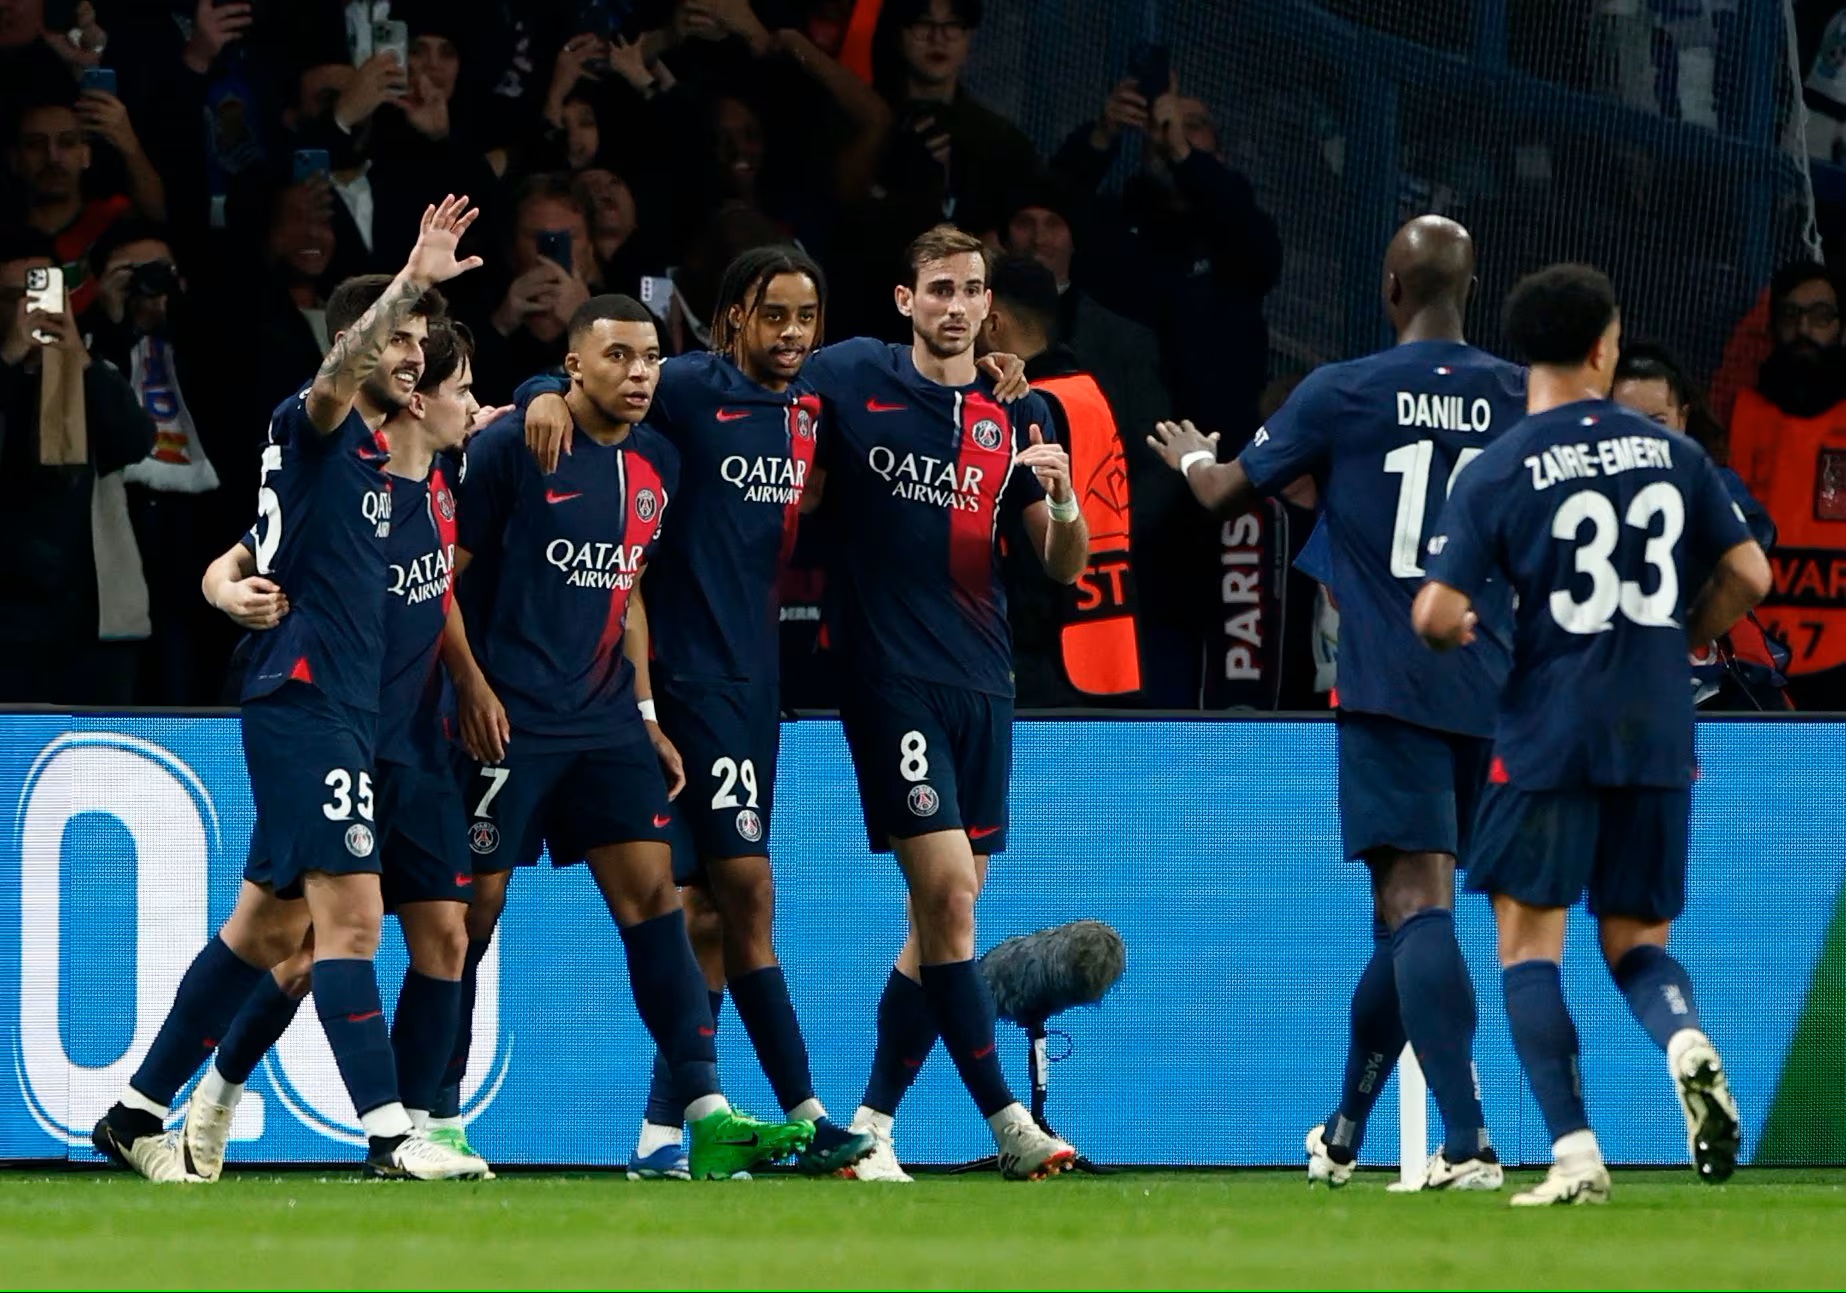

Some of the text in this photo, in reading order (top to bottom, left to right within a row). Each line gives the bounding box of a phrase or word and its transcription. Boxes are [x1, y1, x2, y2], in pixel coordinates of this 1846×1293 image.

[1397, 391, 1491, 432] DANILO
[720, 455, 806, 489] QATAR
[743, 485, 803, 505] AIRWAY
[868, 446, 984, 495] QATAR
[892, 481, 980, 513] AIRWAYS
[1383, 440, 1487, 578] 1
[546, 538, 644, 572] QATAR
[1550, 481, 1685, 635] 33
[407, 574, 453, 606] AIRWAY
[1220, 511, 1263, 681] PARIS
[900, 730, 930, 782] 8
[322, 768, 374, 822] 35
[474, 767, 511, 819] 7
[711, 756, 760, 810] 29
